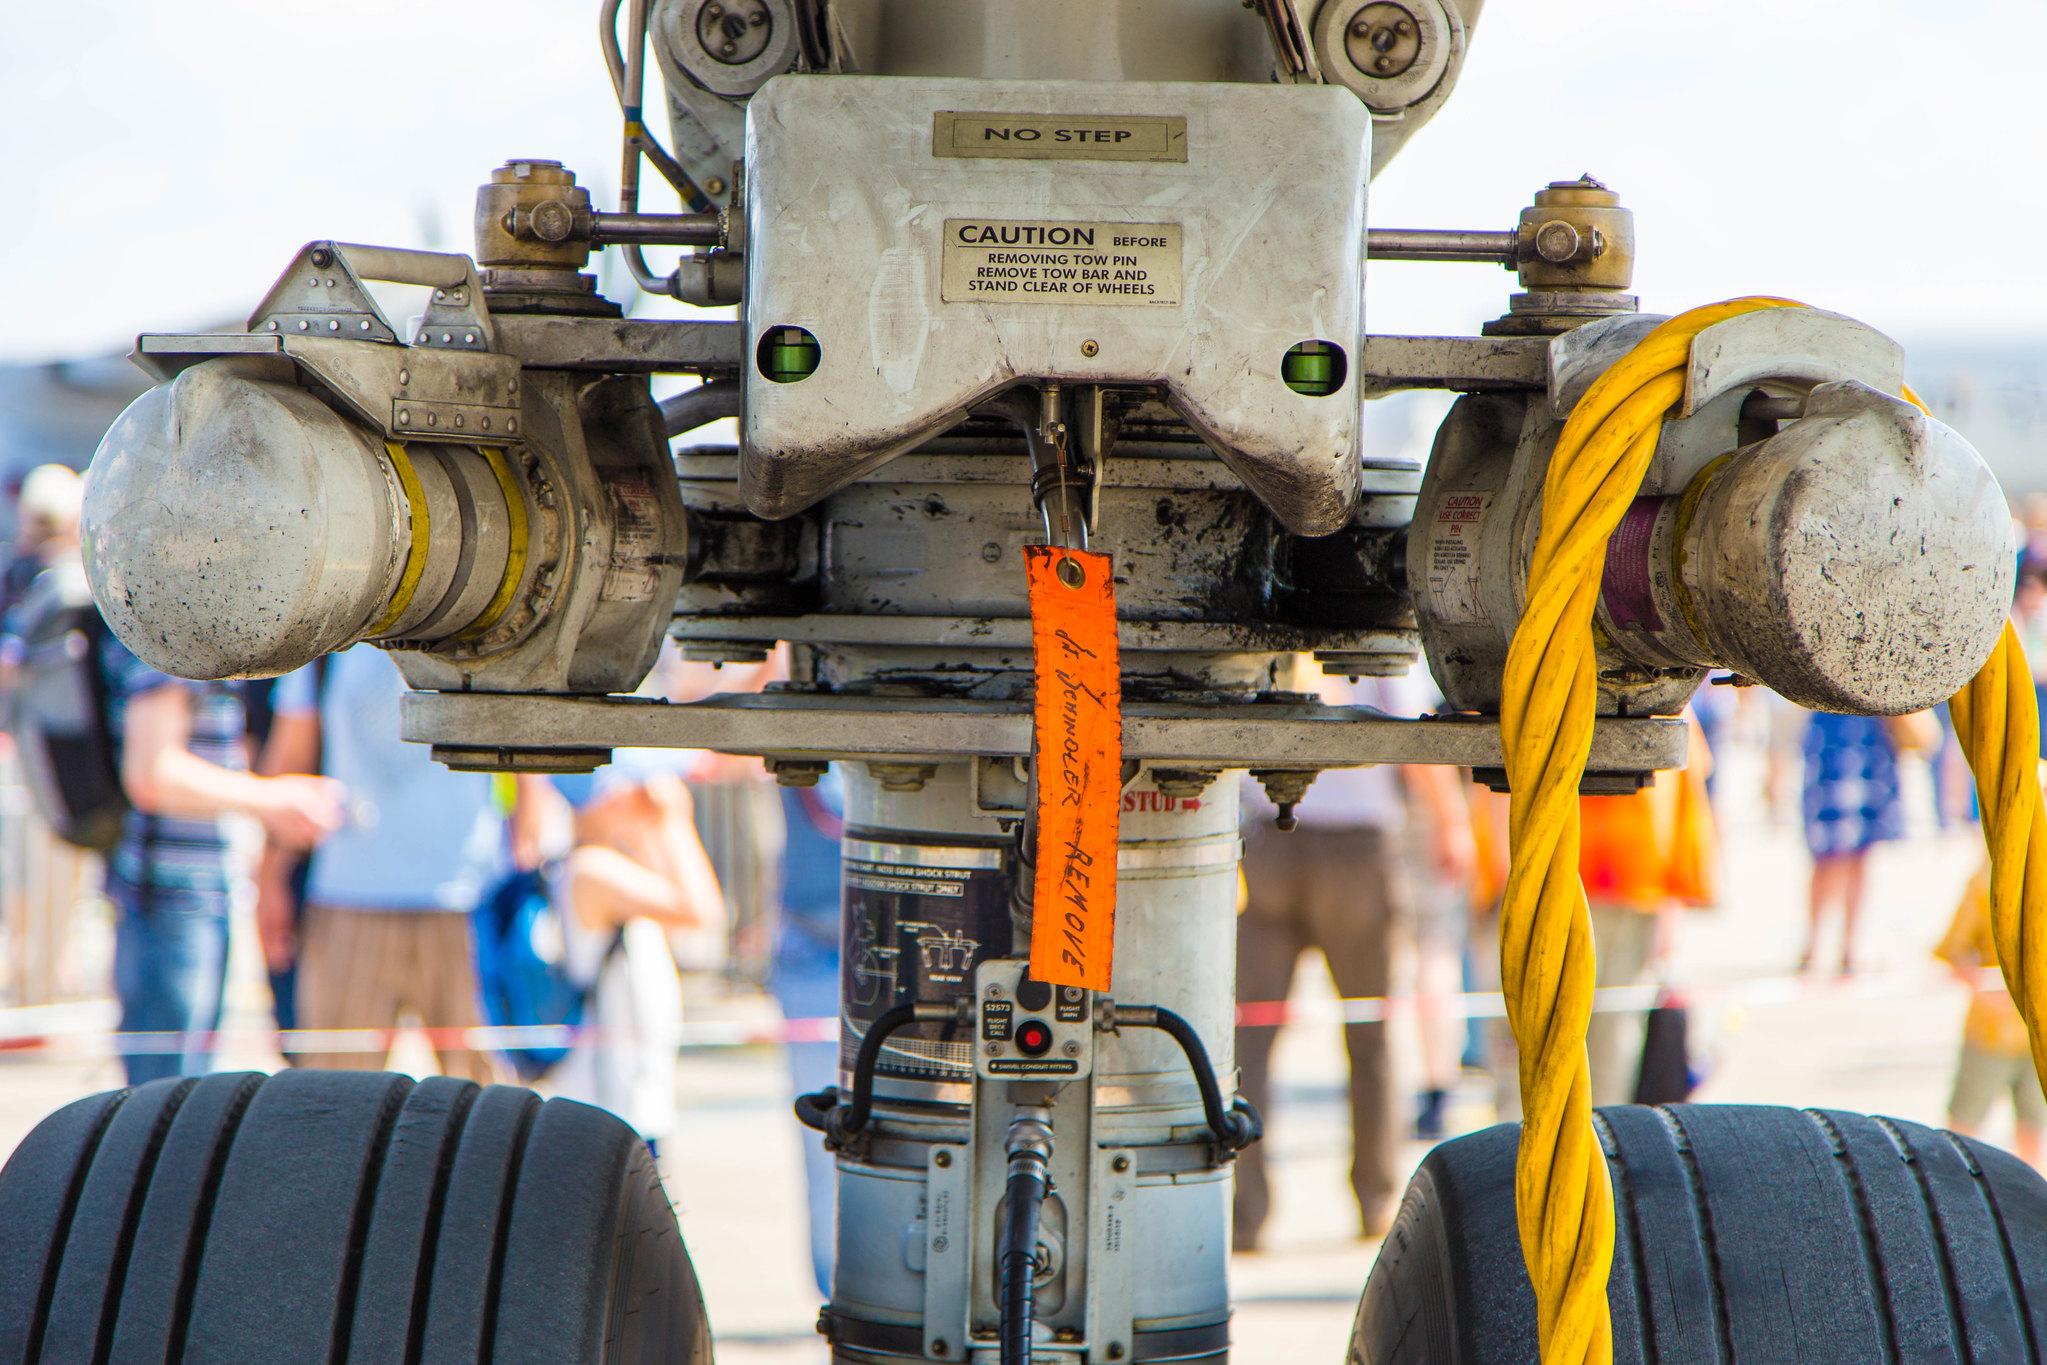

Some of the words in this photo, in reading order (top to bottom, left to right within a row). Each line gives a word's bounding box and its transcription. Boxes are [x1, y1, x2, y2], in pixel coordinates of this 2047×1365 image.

[984, 127, 1042, 141] NO
[1054, 129, 1132, 143] STEP
[958, 225, 1095, 245] CAUTION
[1113, 236, 1167, 248] BEFORE
[988, 253, 1069, 265] REMOVING
[1073, 254, 1108, 266] TOW
[1113, 255, 1137, 267] PIN
[977, 267, 1037, 279] REMOVE
[1042, 268, 1077, 280] TOW
[1082, 269, 1109, 280] BAR
[1114, 270, 1148, 281] AND
[968, 280, 1018, 292] STAND
[1023, 281, 1067, 293] CLEAR
[1072, 282, 1094, 294] OF
[1098, 283, 1155, 295] WHEELS
[1447, 496, 1484, 507] CAUTION
[1439, 511, 1451, 520] USE
[1452, 511, 1482, 521] CORRECT
[1450, 524, 1462, 534] PIN
[1123, 791, 1176, 812] STUD
[896, 866, 914, 875] GEAR
[915, 867, 943, 878] SHOCK
[945, 870, 972, 880] STRUT
[887, 882, 910, 891] SHOCK
[911, 883, 935, 892] STRUT
[936, 885, 960, 894] ONLY
[1062, 841, 1093, 977] REMOVE
